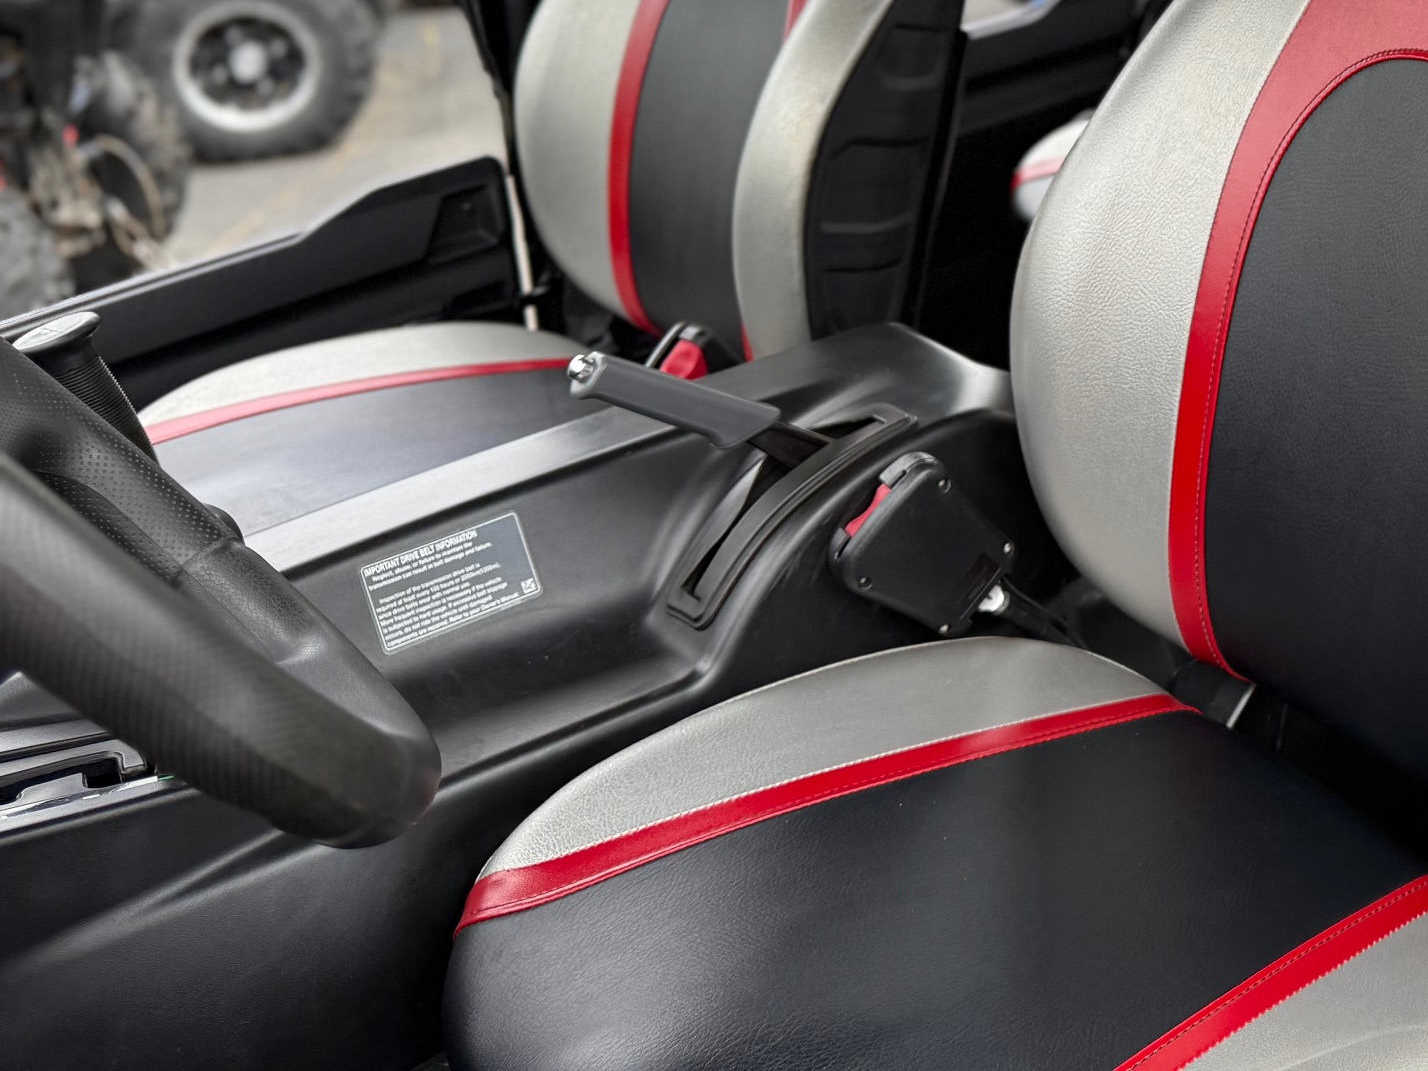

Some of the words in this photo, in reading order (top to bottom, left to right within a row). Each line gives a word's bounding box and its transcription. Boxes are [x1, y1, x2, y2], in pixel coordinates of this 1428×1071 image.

[363, 557, 400, 577] IMPORTANT
[399, 550, 419, 564] DRIVE
[419, 544, 435, 557] BELT
[434, 529, 477, 551] INFORMATION
